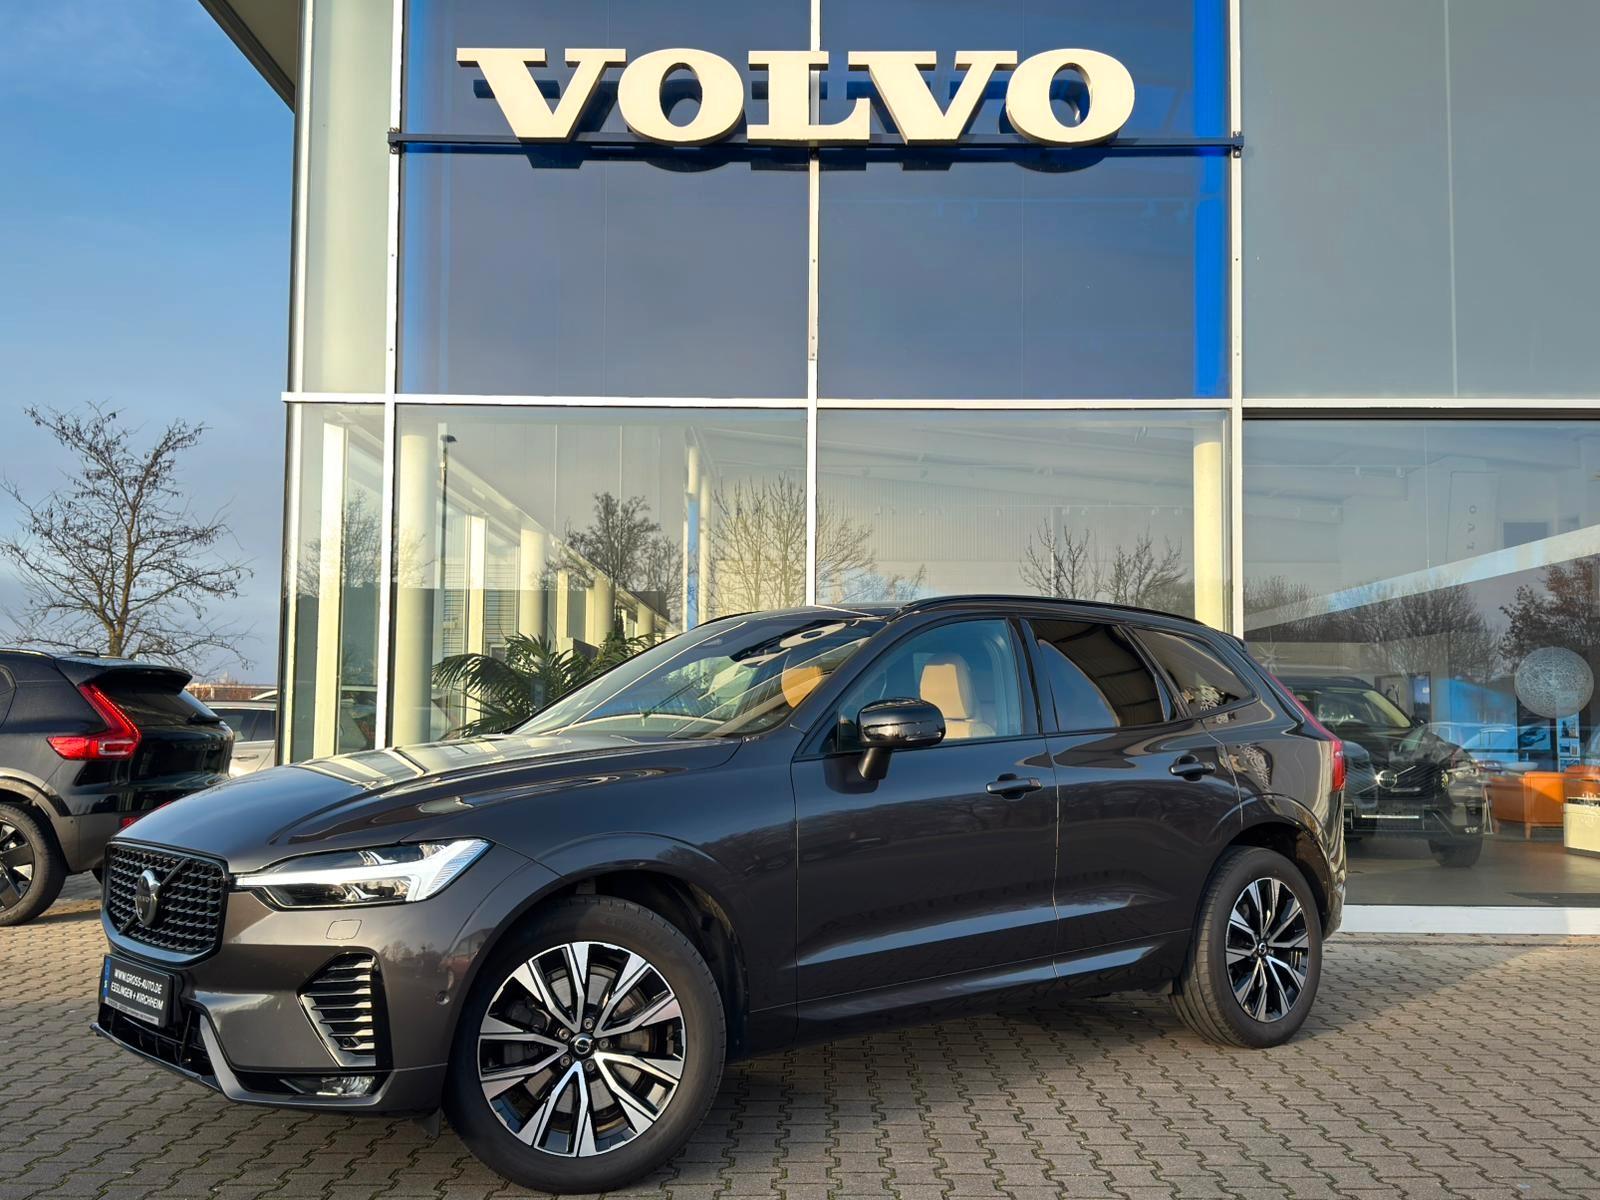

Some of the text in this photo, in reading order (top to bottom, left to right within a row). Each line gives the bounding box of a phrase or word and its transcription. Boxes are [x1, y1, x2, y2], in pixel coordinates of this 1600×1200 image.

[456, 47, 1135, 146] VOLVO
[111, 981, 133, 999] ESSLINGEN
[114, 968, 162, 994] WWW.GROSS-AUTO.DE
